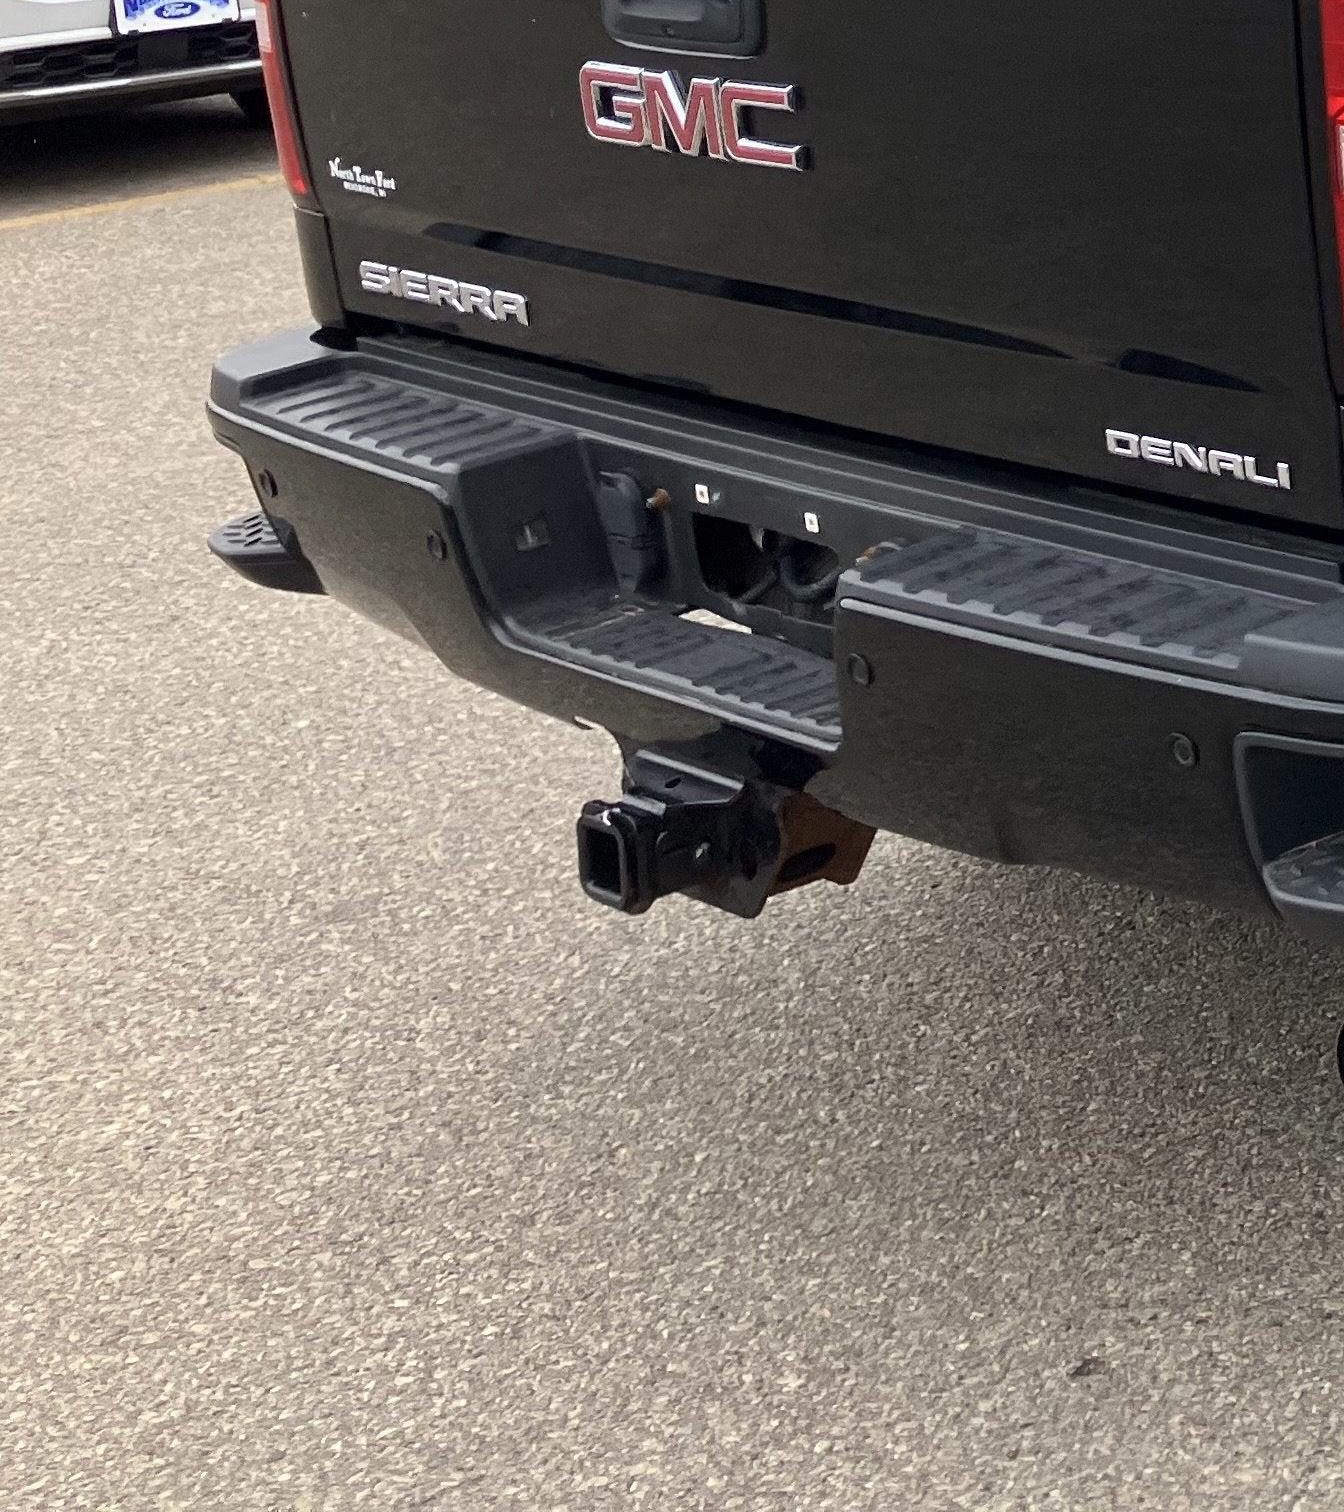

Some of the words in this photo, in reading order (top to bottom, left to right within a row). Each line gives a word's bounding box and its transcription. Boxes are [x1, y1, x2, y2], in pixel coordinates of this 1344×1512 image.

[161, 3, 192, 18] Ford
[579, 60, 805, 171] GMC
[359, 260, 530, 327] SIERRA
[1105, 428, 1291, 489] DENALI
